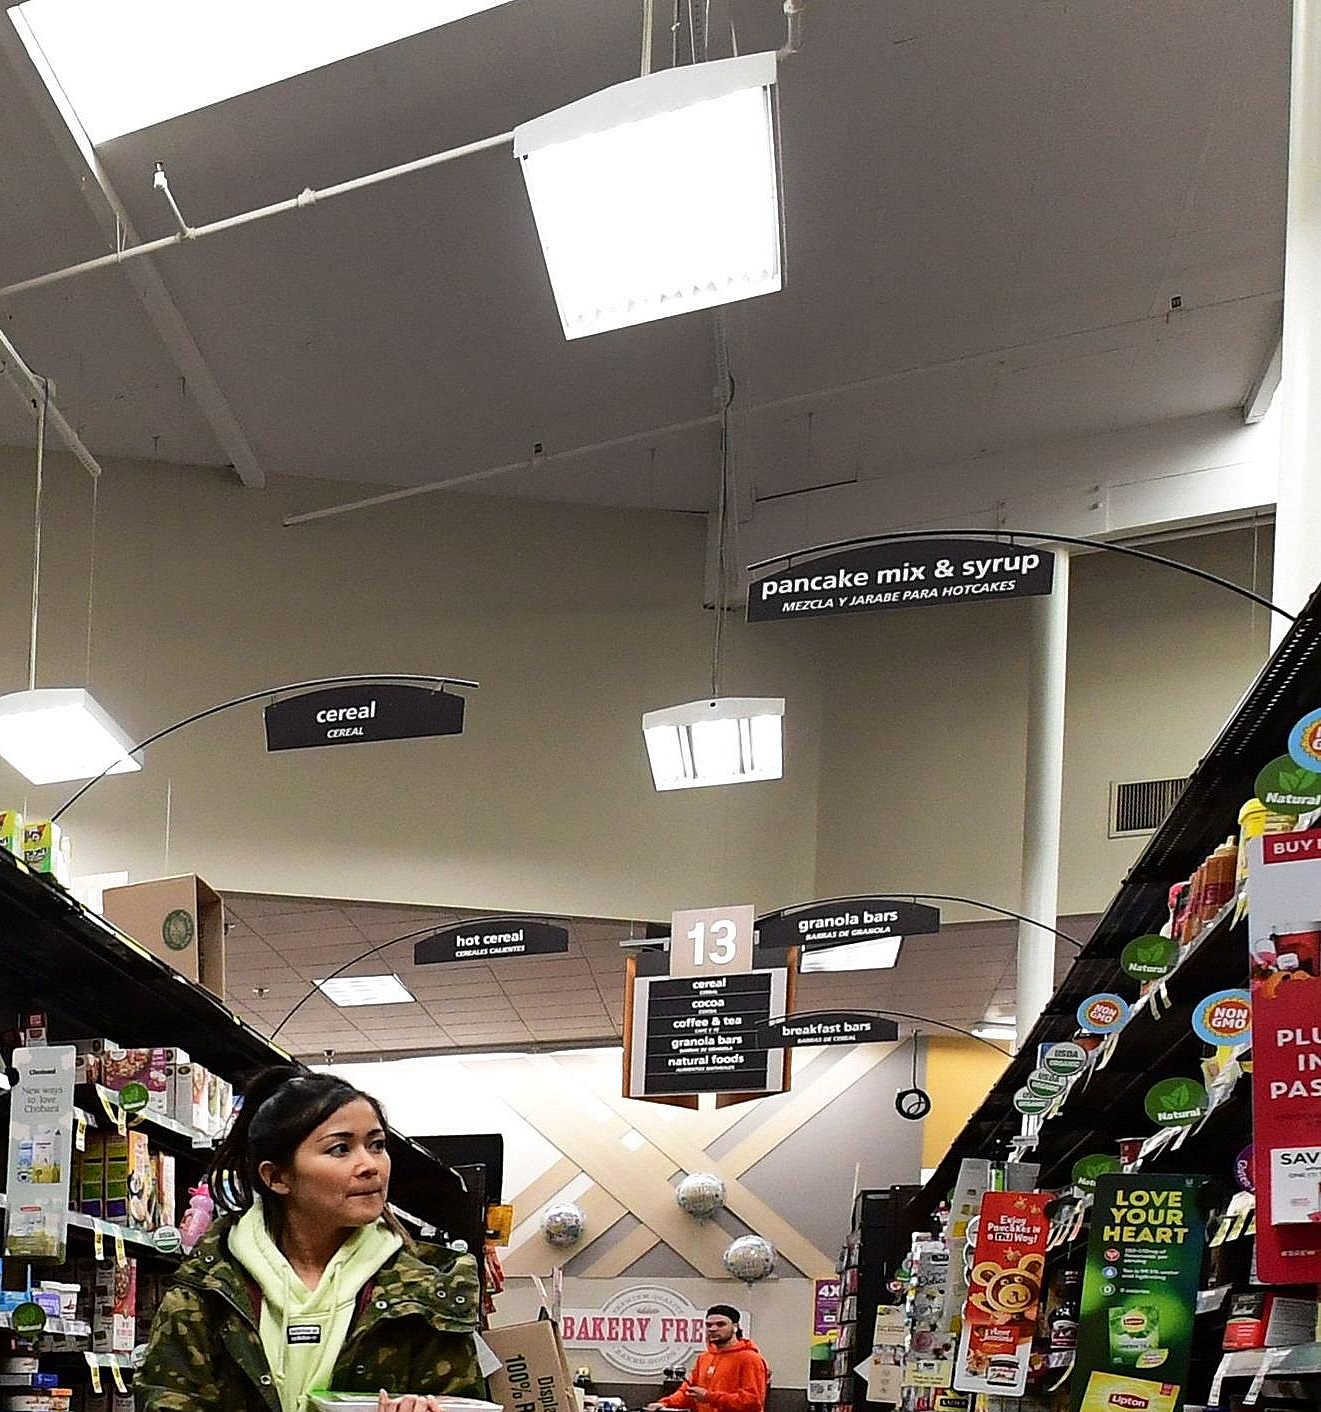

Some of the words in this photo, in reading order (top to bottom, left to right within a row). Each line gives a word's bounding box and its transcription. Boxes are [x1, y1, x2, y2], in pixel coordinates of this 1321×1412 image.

[762, 568, 868, 599] pancake
[877, 562, 925, 585] mix
[934, 559, 954, 579] &
[962, 551, 1040, 580] syrup
[782, 597, 834, 612] MEZCLA
[838, 596, 847, 607] Y
[849, 591, 899, 606] JARABE
[902, 588, 938, 601] PARA
[941, 579, 1016, 598] HOTCAKES
[316, 701, 376, 723] cereal
[327, 727, 363, 738] CEREAL
[1266, 792, 1321, 805] Natural
[1273, 839, 1314, 855] BUY
[799, 913, 858, 933] granola
[863, 910, 898, 924] bars
[457, 935, 480, 947] hot
[483, 930, 523, 945] cereal
[806, 931, 838, 940] BARRAS
[839, 930, 849, 938] DE
[852, 926, 891, 936] GRANOLA
[688, 920, 736, 966] 13
[1128, 963, 1167, 973] Natural
[693, 978, 726, 989] cereal
[692, 999, 724, 1008] cocoa
[1094, 1004, 1117, 1016] NON
[1214, 1007, 1248, 1019] NON
[673, 1018, 708, 1028] coffee
[711, 1017, 720, 1026] &
[723, 1016, 742, 1025] tea
[783, 1024, 840, 1036] breakfast
[844, 1022, 871, 1032] bars
[1211, 1017, 1247, 1029] GMO
[671, 1036, 714, 1049] granola
[718, 1035, 742, 1045] bars
[668, 1055, 708, 1066] natural
[712, 1054, 744, 1064] foods
[1055, 1049, 1078, 1057] USDA
[1157, 1108, 1201, 1120] Natural
[1116, 1190, 1182, 1207] LOVE
[1001, 1215, 1026, 1226] Enjoy
[1110, 1208, 1184, 1226] YOUR
[1015, 1233, 1037, 1245] Way!
[1103, 1225, 1189, 1244] HEART
[562, 1316, 651, 1342] BAKERY
[660, 1318, 707, 1343] FRE
[506, 1354, 531, 1399] 100%
[1112, 1394, 1147, 1408] Lipton
